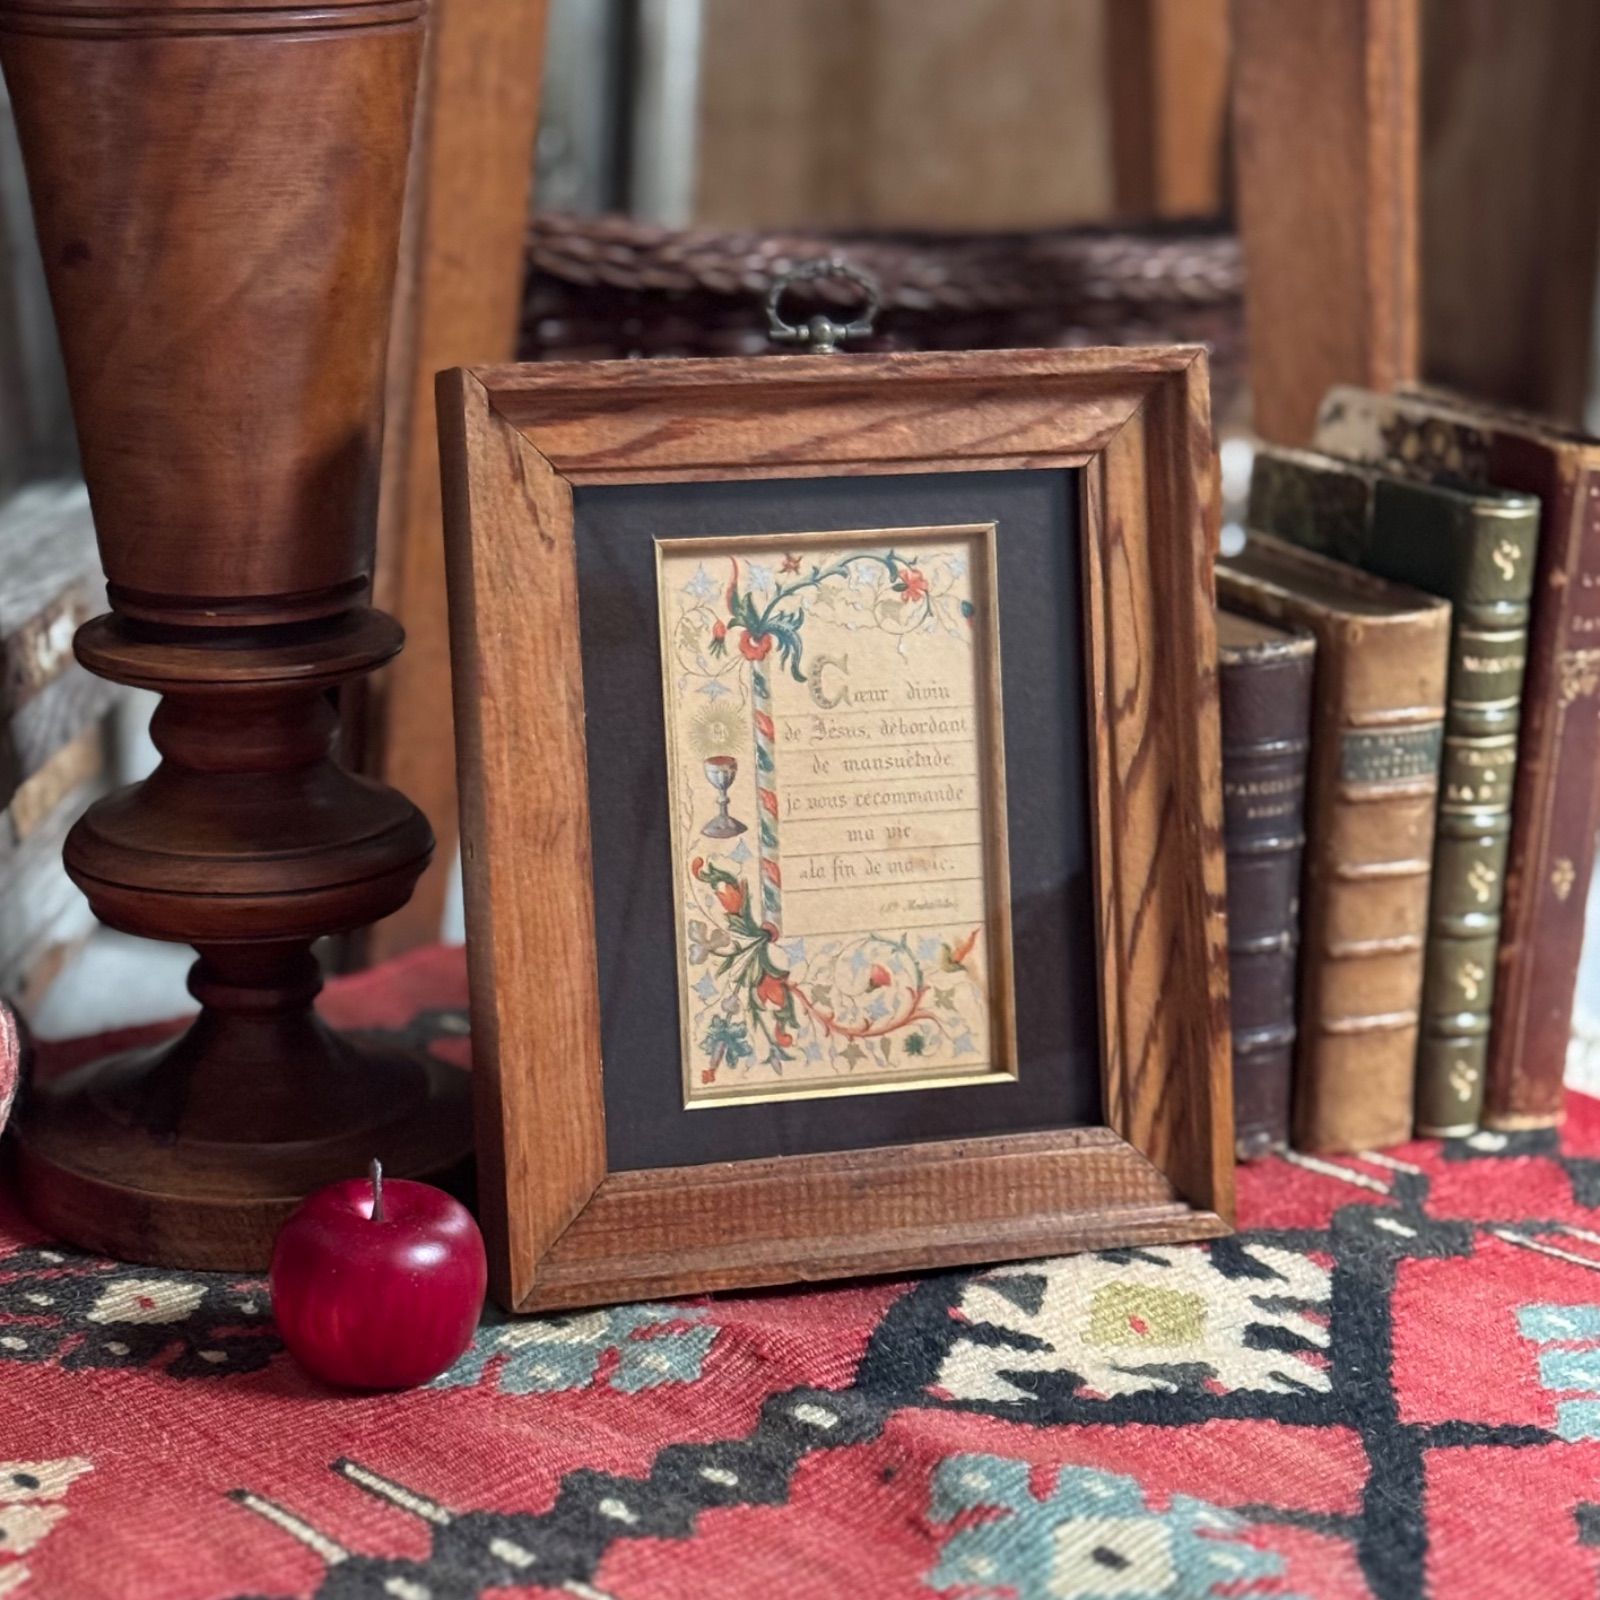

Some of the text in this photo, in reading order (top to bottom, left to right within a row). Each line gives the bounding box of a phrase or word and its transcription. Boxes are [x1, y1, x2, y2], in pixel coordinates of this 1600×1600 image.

[808, 653, 952, 709] Cœur divin
[784, 722, 801, 742] de
[812, 754, 830, 775] de
[786, 784, 965, 815] je vous recommande
[847, 820, 913, 843] ma vie
[832, 855, 857, 884] fin
[864, 855, 881, 876] de
